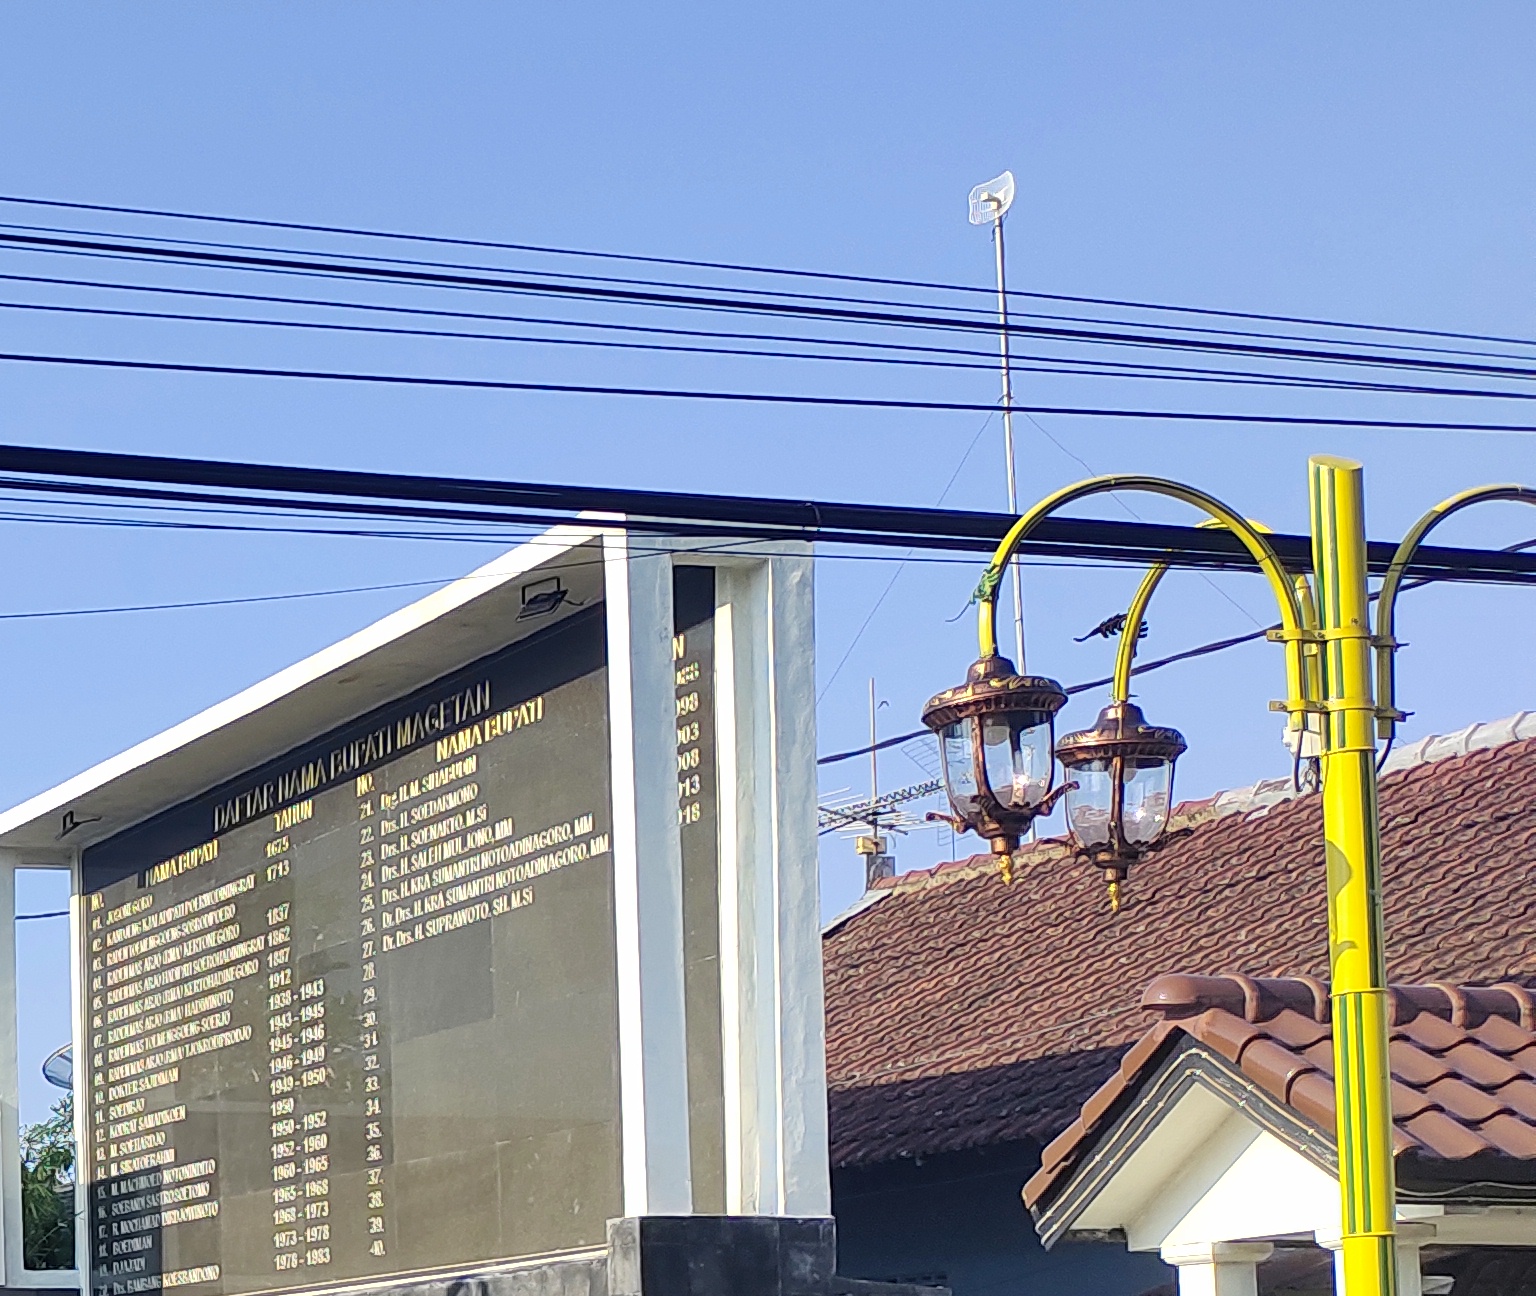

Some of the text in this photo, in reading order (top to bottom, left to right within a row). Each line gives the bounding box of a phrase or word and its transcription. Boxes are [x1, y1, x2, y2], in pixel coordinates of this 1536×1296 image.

[213, 678, 490, 833] DAFTAR NAMA BUPATI MAGETAN
[355, 694, 544, 798] NO. NAMA BUPATI
[359, 824, 374, 845] 22.
